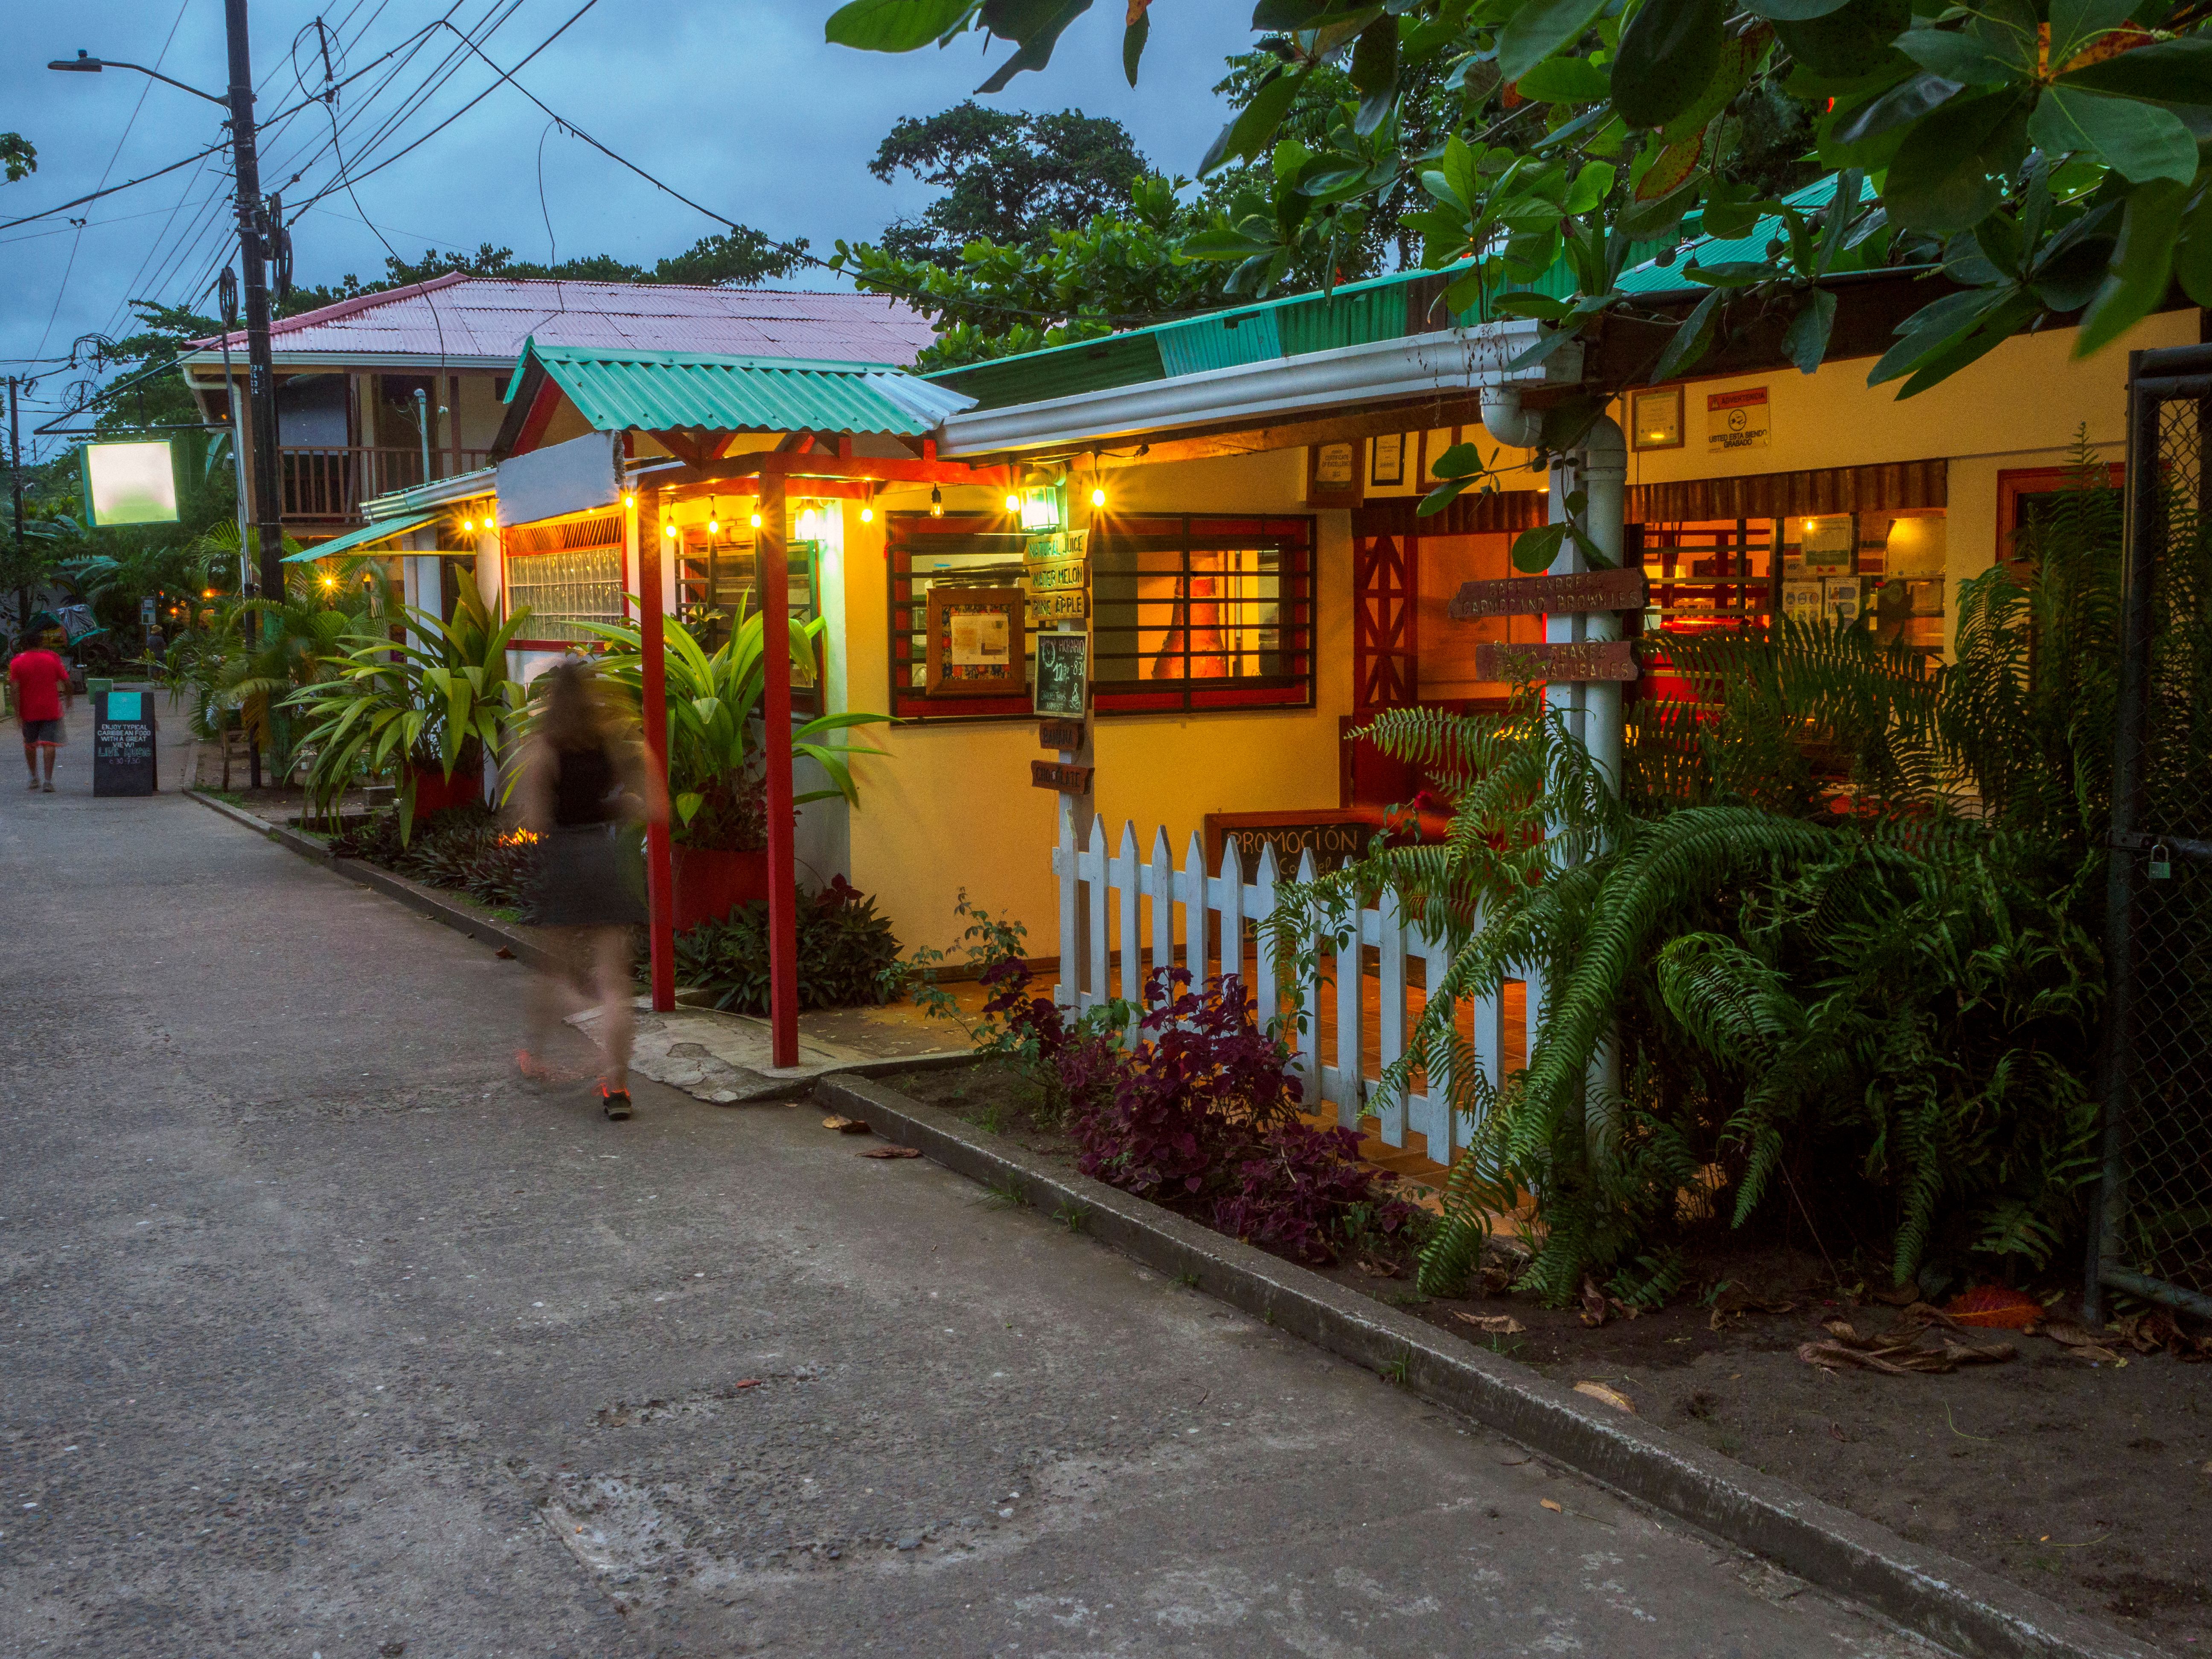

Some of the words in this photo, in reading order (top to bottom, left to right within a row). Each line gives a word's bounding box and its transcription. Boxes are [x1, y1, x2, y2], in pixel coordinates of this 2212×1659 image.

[1722, 392, 1764, 404] ADVERTENCIA
[1708, 434, 1728, 443] USTED
[1745, 429, 1767, 438] SIENDO
[1724, 439, 1752, 448] GRABADO
[1029, 539, 1060, 558] NATURAL
[1063, 535, 1083, 553] JUICE
[1032, 570, 1056, 588] WATER
[1058, 566, 1083, 585] MELON
[1536, 575, 1603, 593] EXPRESS
[1033, 600, 1051, 616] PINE
[1056, 596, 1082, 614] APPLE
[1463, 598, 1545, 615] CAPUCCINO
[1557, 591, 1639, 613] BROWNIES
[1059, 639, 1084, 655] HORARIO
[1551, 645, 1607, 661] SHAKES
[1541, 662, 1628, 679] NATURALES
[1042, 727, 1073, 745] BANANA
[98, 747, 120, 757] LIVE
[124, 747, 151, 758] MUSIC
[1036, 766, 1080, 787] CHOCOLATE
[1279, 856, 1332, 874] Coel
